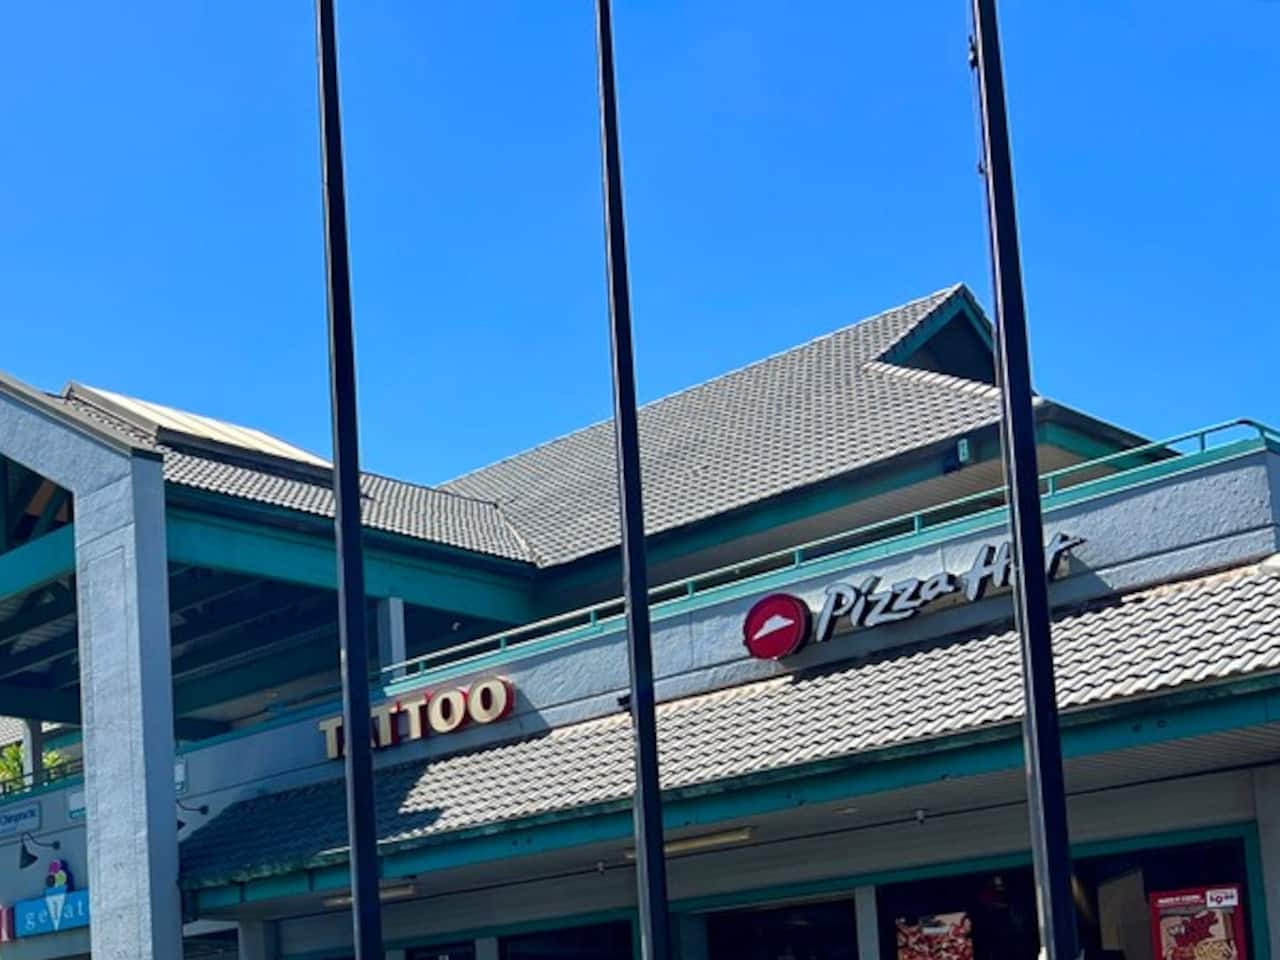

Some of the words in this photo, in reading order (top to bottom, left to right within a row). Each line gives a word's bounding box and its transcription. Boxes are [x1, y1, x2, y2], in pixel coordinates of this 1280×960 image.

[817, 571, 956, 642] Pizza
[962, 532, 1087, 601] Ht
[318, 674, 515, 760] TTTOO
[24, 899, 87, 931] gelat
